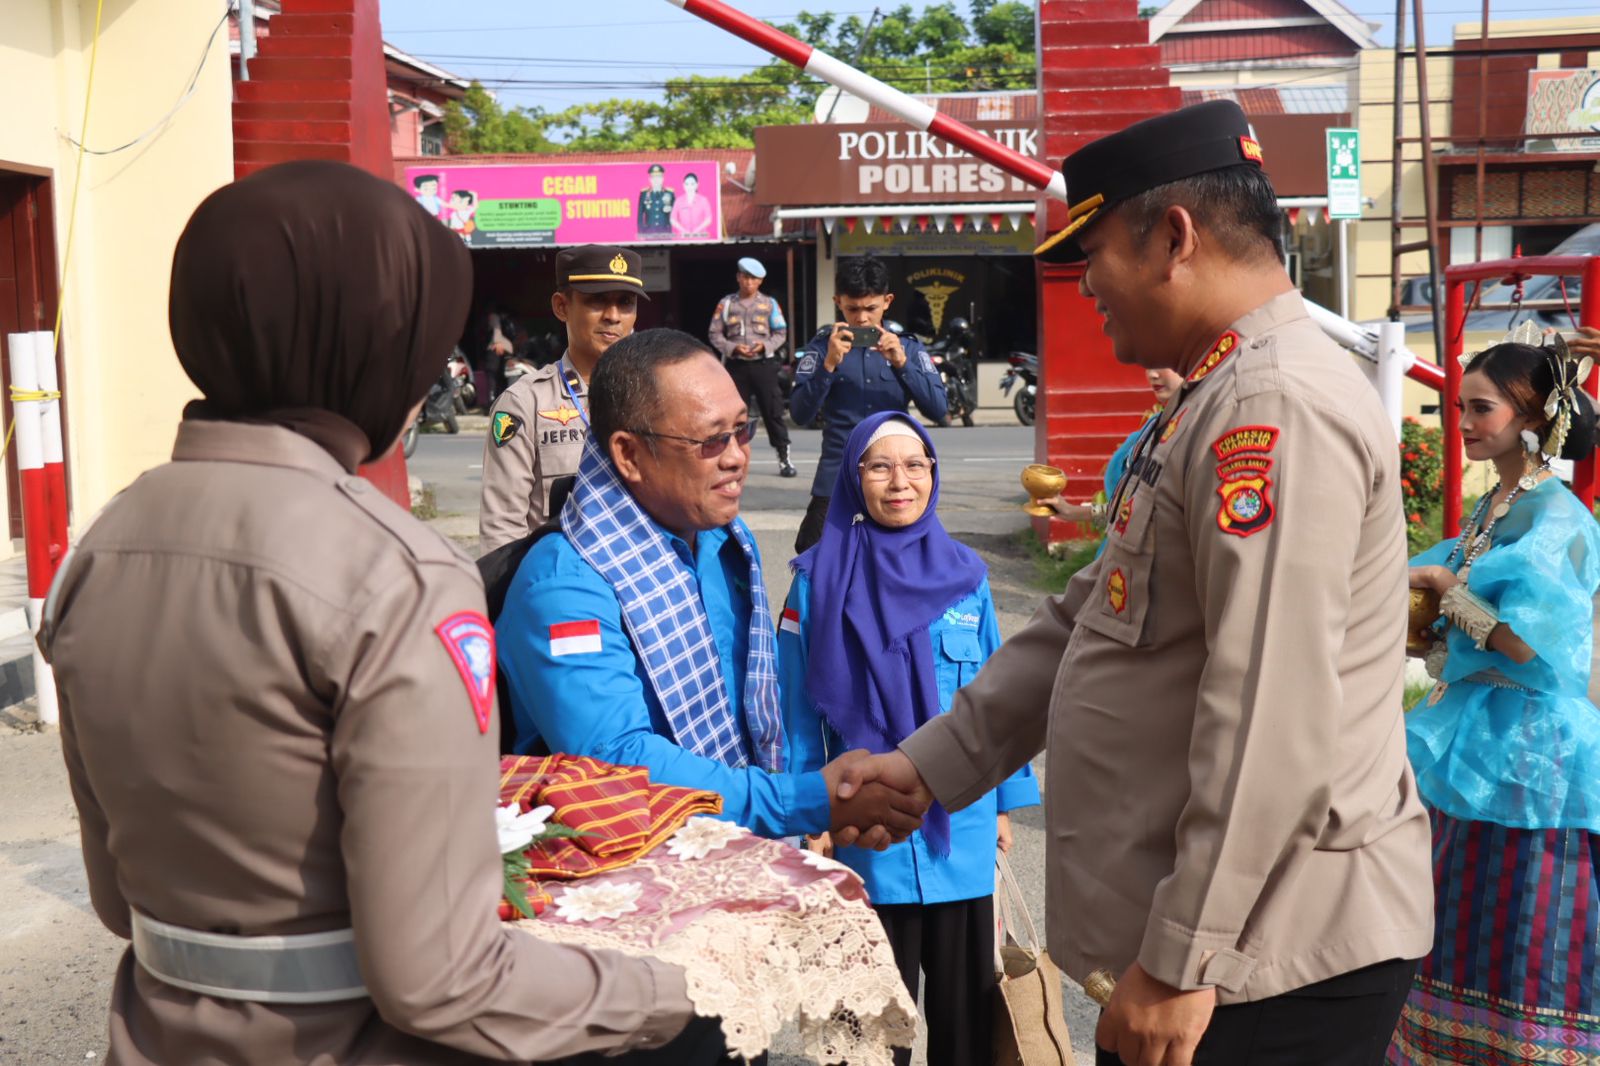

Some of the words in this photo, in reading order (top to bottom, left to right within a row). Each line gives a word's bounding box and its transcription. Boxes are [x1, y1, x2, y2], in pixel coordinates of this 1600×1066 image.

[543, 175, 597, 195] CEGAH
[566, 199, 631, 219] STUNTING
[907, 268, 965, 284] POLIKLINIK
[541, 429, 587, 445] JEFRY
